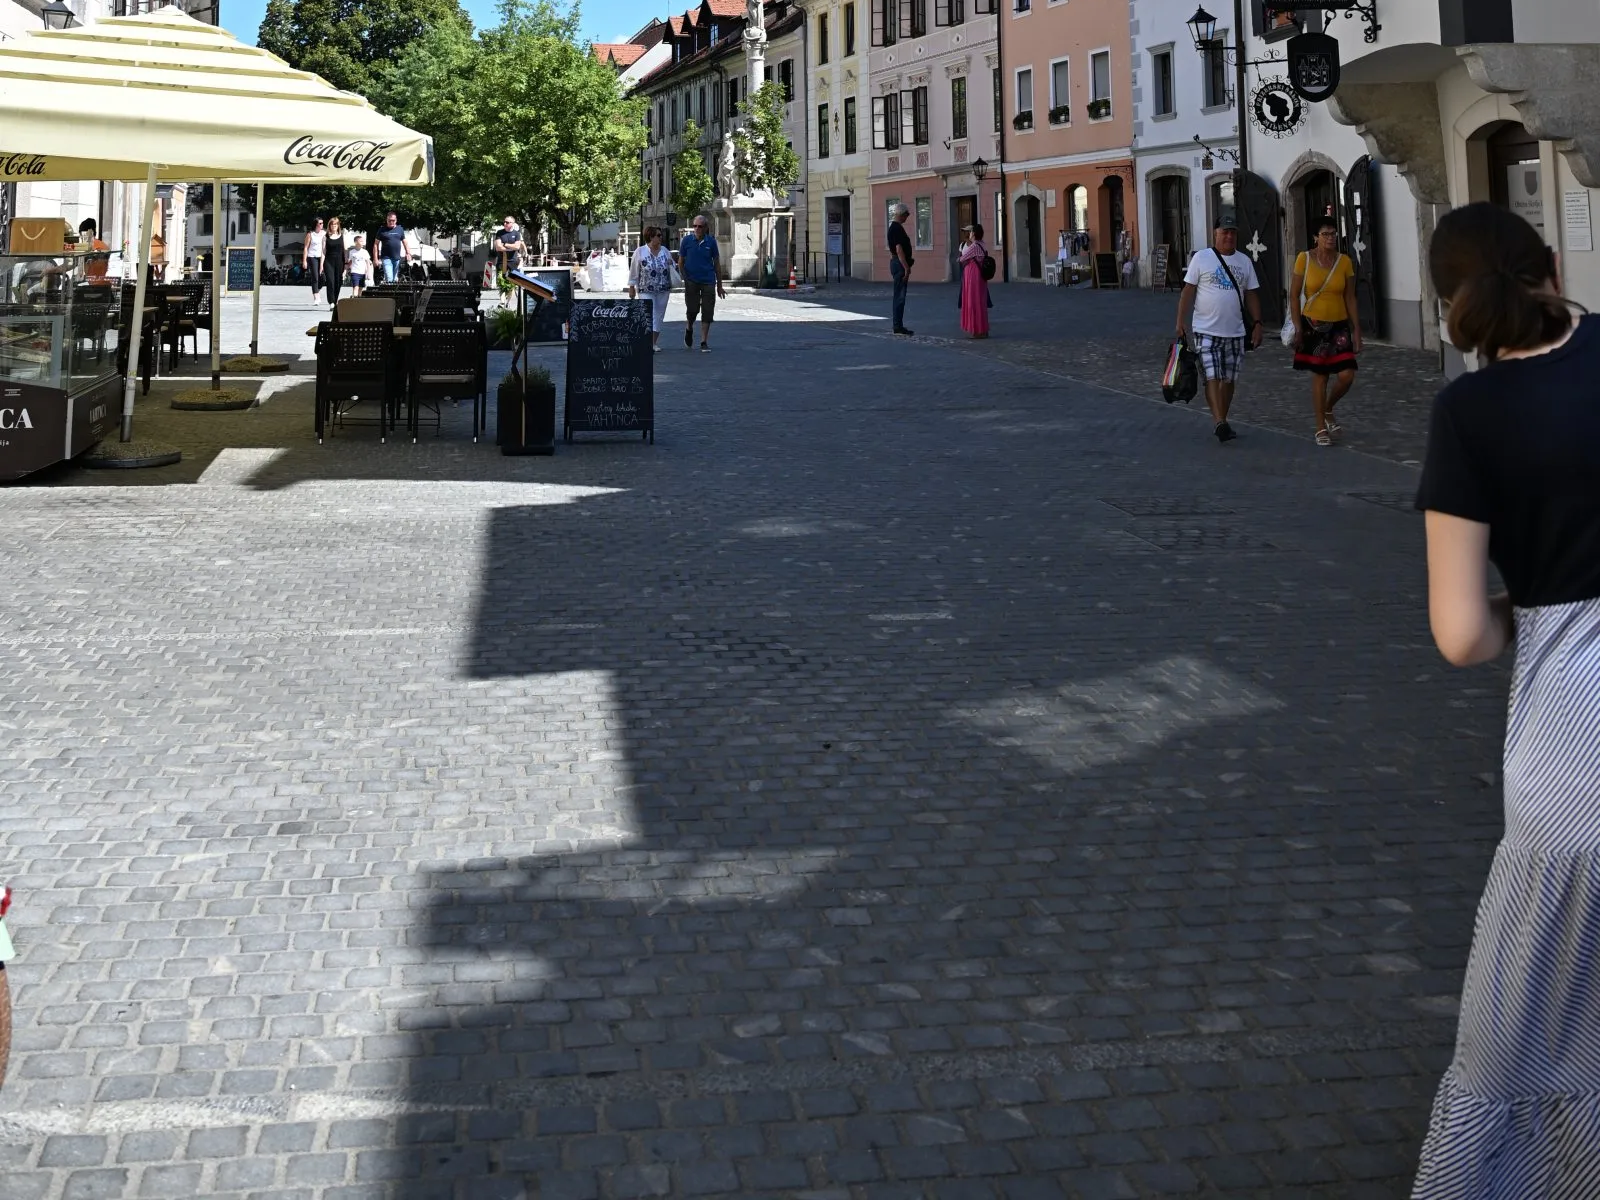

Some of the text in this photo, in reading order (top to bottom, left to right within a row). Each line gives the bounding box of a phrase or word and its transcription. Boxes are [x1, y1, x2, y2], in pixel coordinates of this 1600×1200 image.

[1262, 119, 1294, 131] MILENA
[283, 135, 393, 172] Coca-Cola
[592, 305, 629, 318] Coca-Cola
[601, 357, 622, 370] VRT
